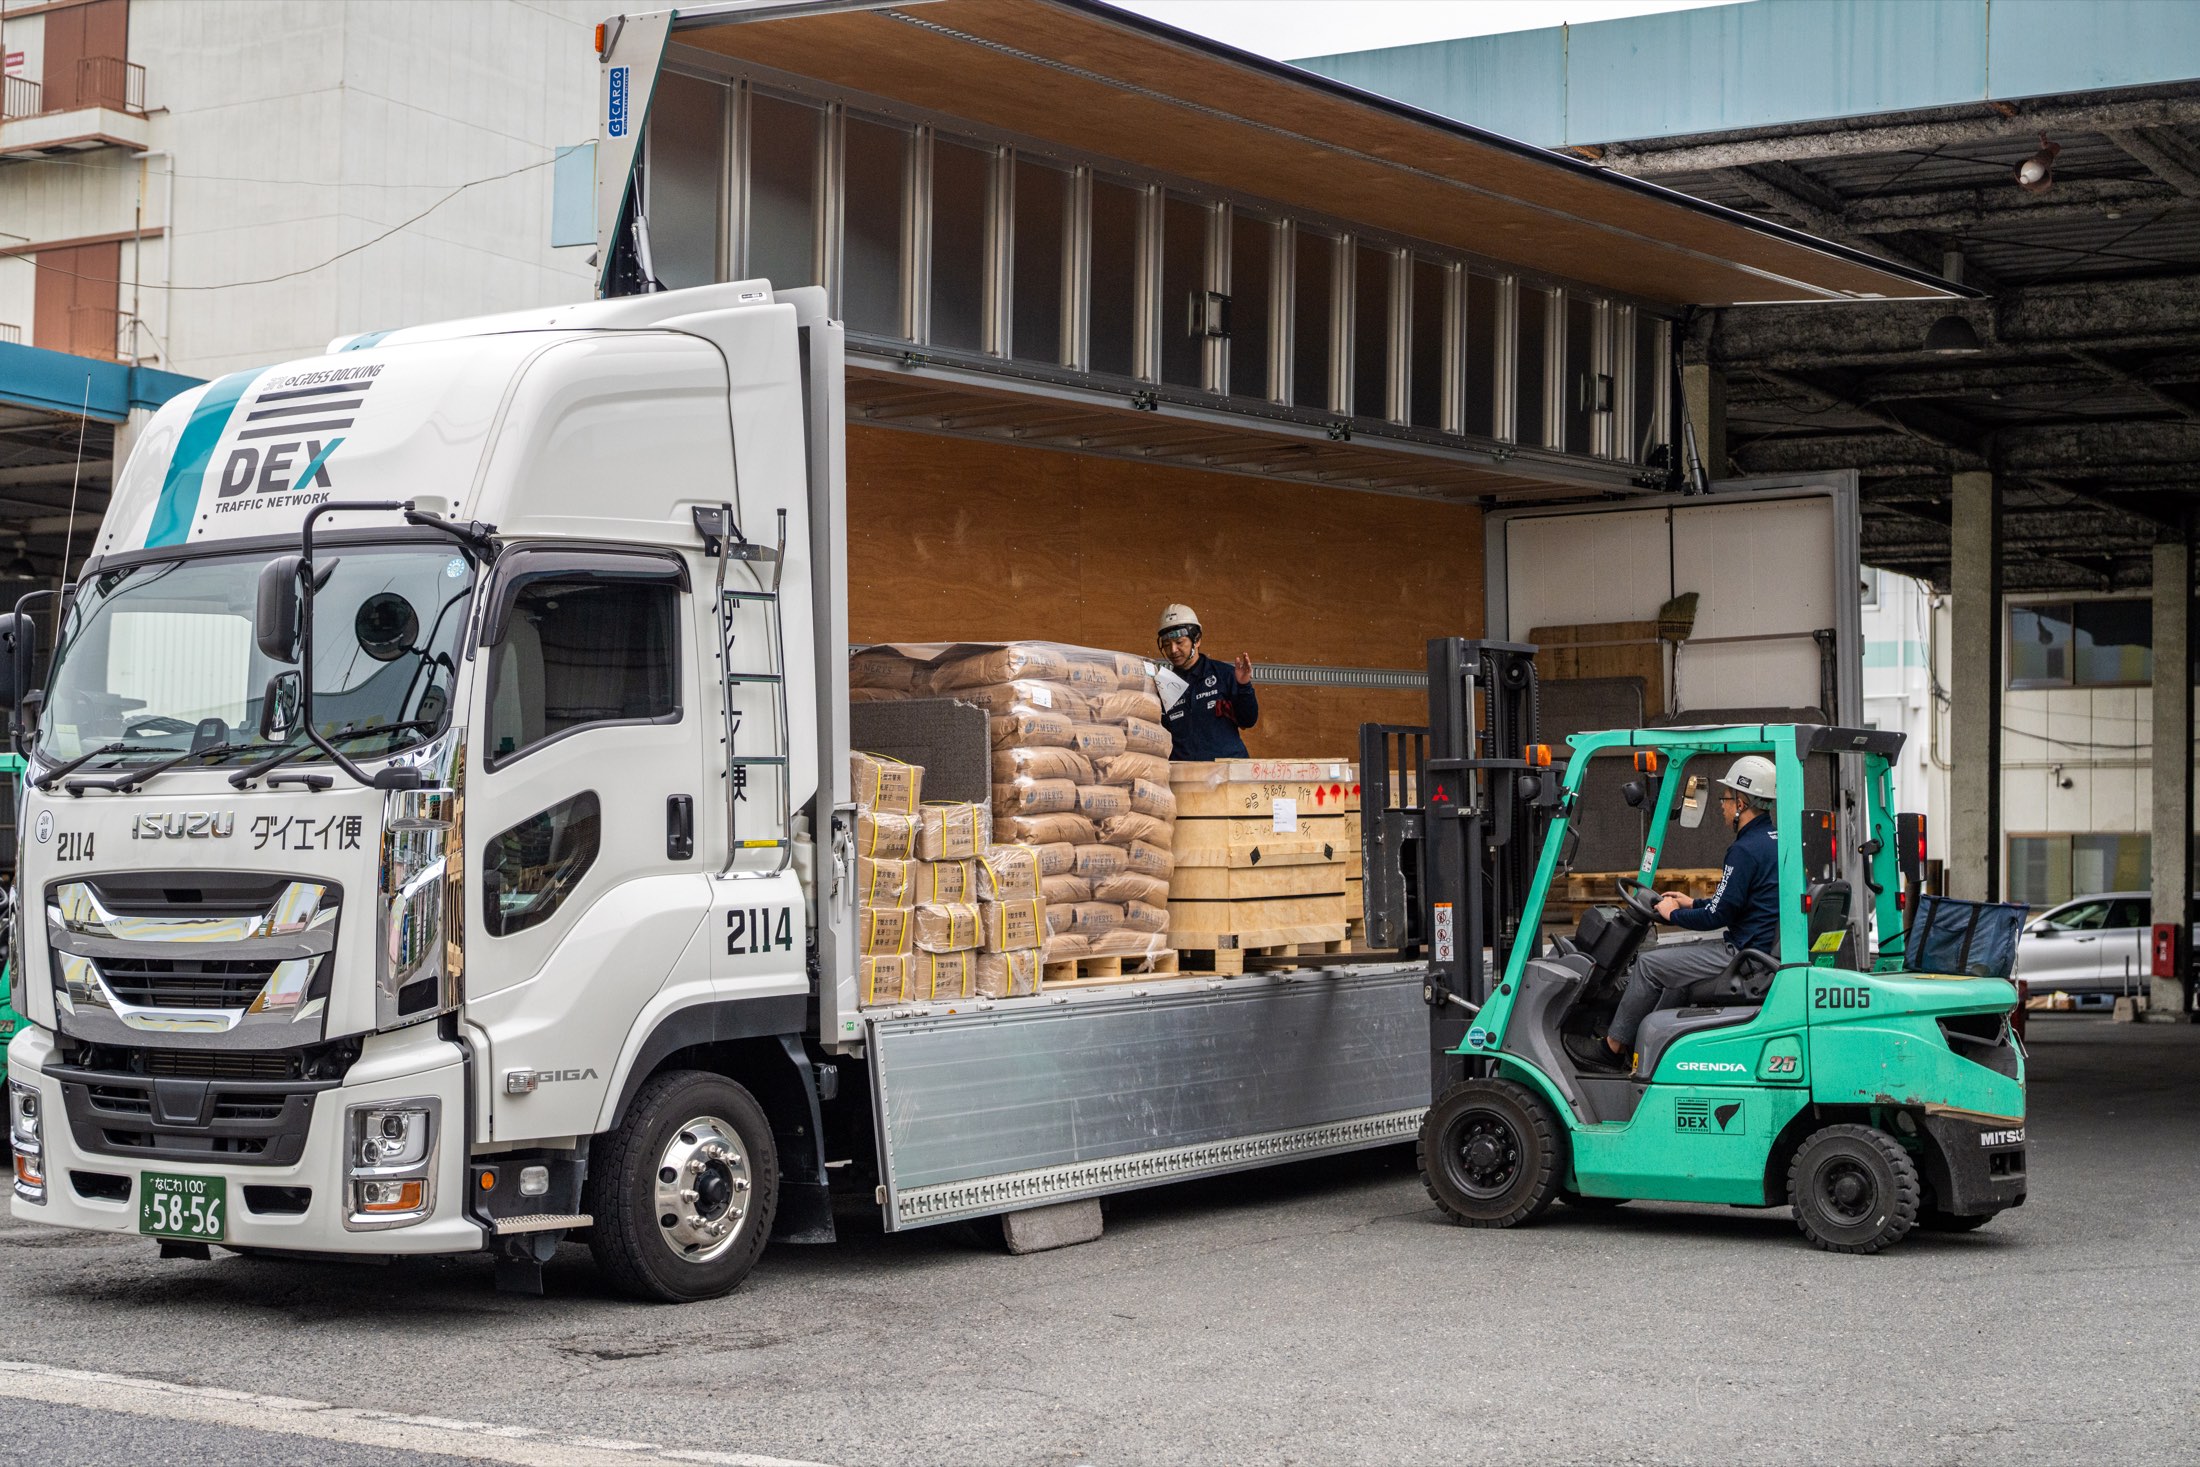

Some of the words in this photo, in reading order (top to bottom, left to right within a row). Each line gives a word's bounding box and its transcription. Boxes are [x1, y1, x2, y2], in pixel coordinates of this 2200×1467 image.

[328, 363, 386, 382] DOCKING
[218, 437, 346, 498] DEX
[215, 498, 263, 514] TRAFFIC
[266, 492, 330, 509] NETWORK
[132, 810, 235, 840] ISUZU
[250, 815, 362, 851] ダイエイ便
[57, 832, 94, 861] 2114
[727, 907, 793, 955] 2114
[1815, 987, 1870, 1009] 2005
[1768, 1055, 1798, 1073] 25
[537, 1068, 599, 1083] GIGA
[1677, 1116, 1708, 1129] DEX
